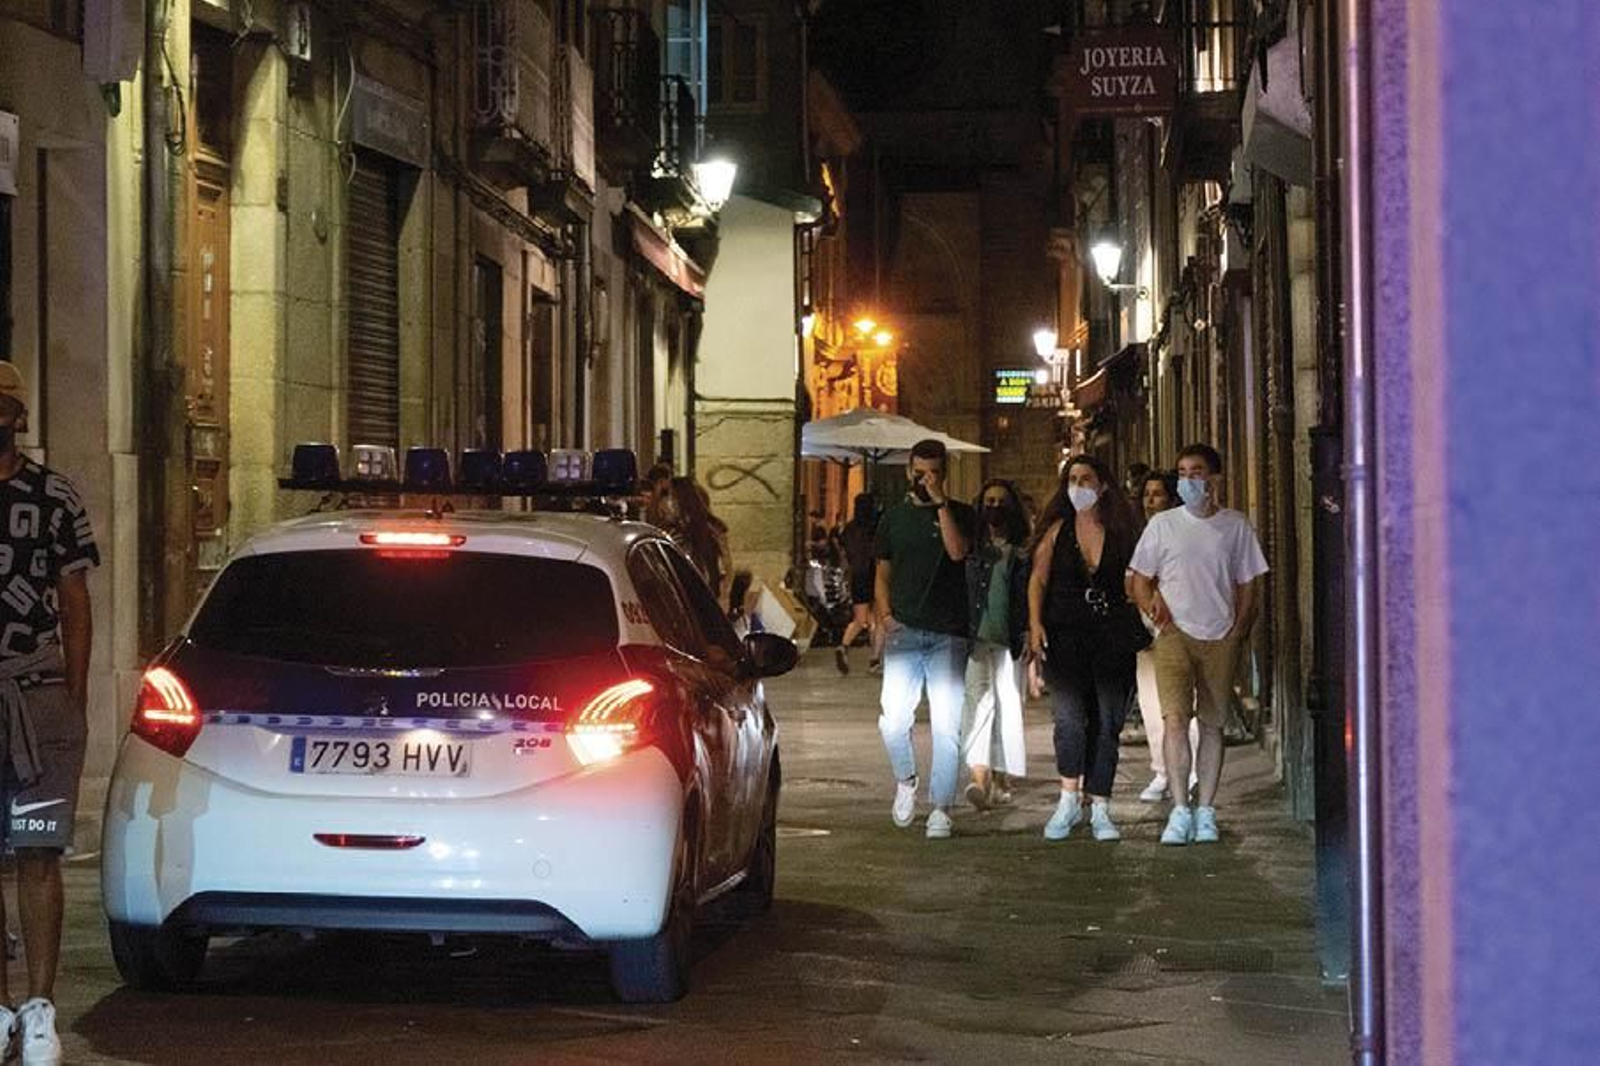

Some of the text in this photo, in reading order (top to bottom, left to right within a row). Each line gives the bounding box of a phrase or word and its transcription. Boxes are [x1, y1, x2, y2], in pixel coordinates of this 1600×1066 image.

[1080, 47, 1166, 75] JOYERIA
[1092, 76, 1156, 96] SUYZA
[416, 692, 563, 711] POLICIA LOCAL
[311, 741, 463, 772] 7793 HVV
[28, 819, 45, 831] DO
[47, 820, 57, 832] IT
